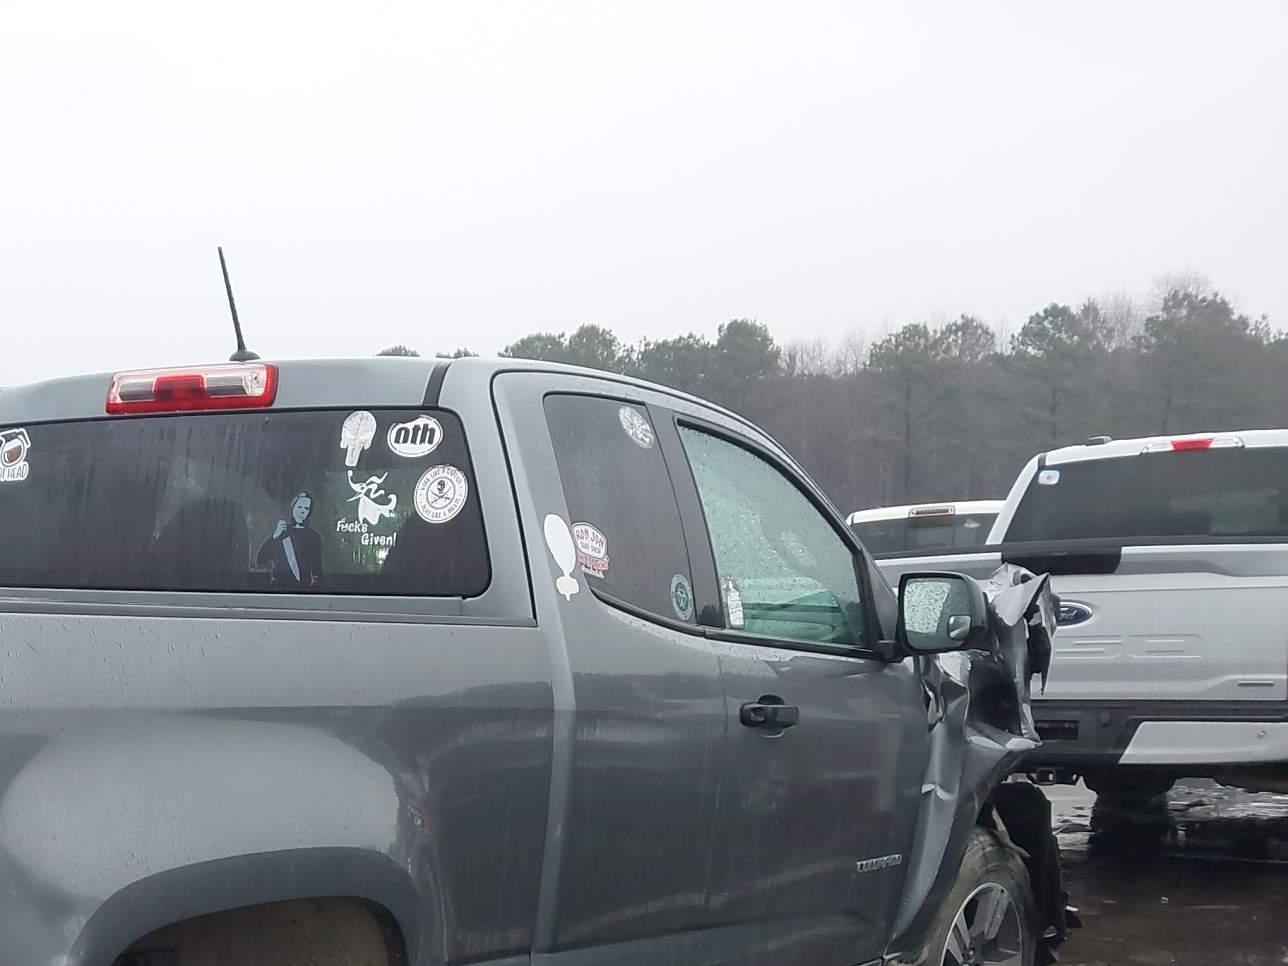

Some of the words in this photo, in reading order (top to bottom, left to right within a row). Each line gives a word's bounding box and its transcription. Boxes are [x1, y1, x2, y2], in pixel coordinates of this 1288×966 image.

[394, 423, 437, 445] nth
[7, 462, 28, 480] HEAD
[336, 518, 368, 533] Fucks
[361, 532, 397, 547] Given!
